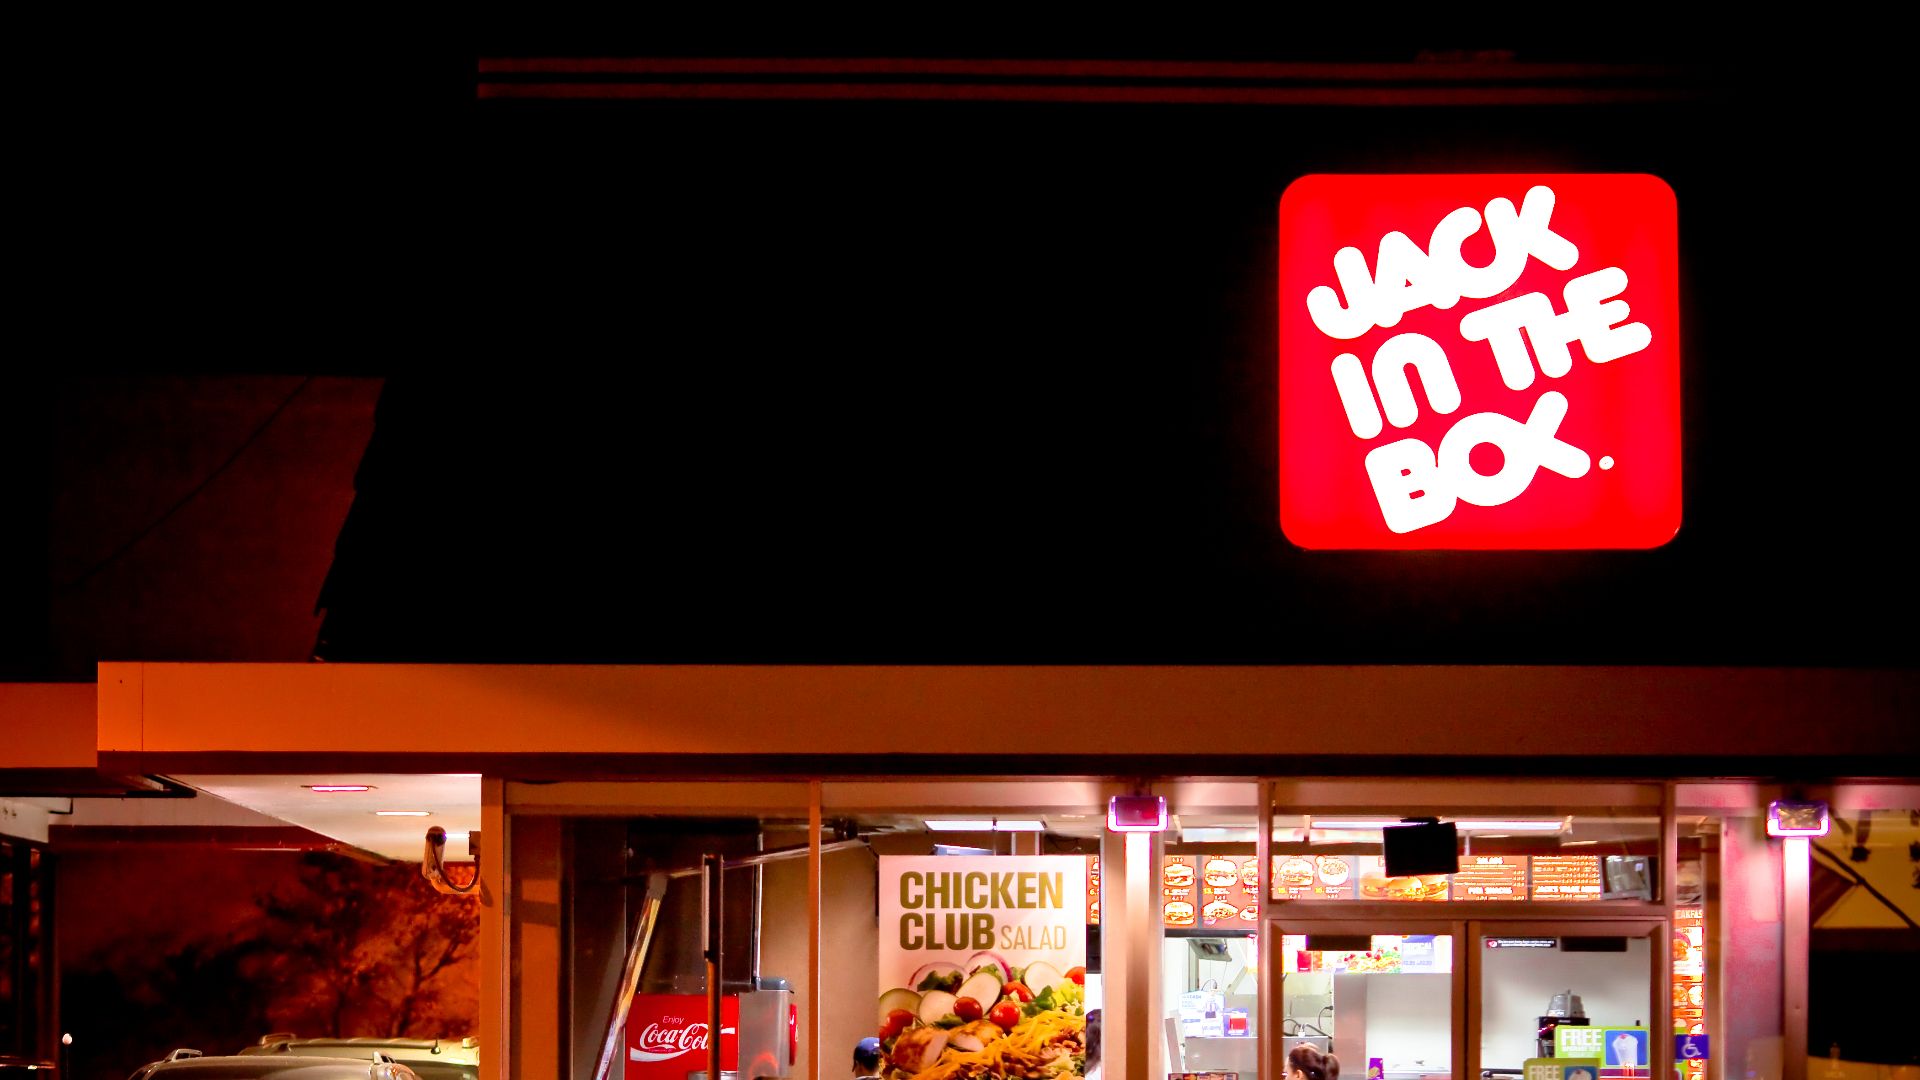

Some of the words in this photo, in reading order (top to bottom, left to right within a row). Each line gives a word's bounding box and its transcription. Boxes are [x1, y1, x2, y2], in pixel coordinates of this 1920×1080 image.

[1306, 185, 1580, 340] JACK
[1459, 266, 1652, 391] THE
[900, 870, 1064, 910] CHICKEN
[900, 912, 996, 951] CLUB
[1000, 924, 1067, 950] SALAD
[639, 1022, 709, 1051] Coca-Col
[662, 1015, 685, 1025] Enjoy
[1560, 1028, 1603, 1046] FREE
[1528, 1065, 1561, 1080] FREE
